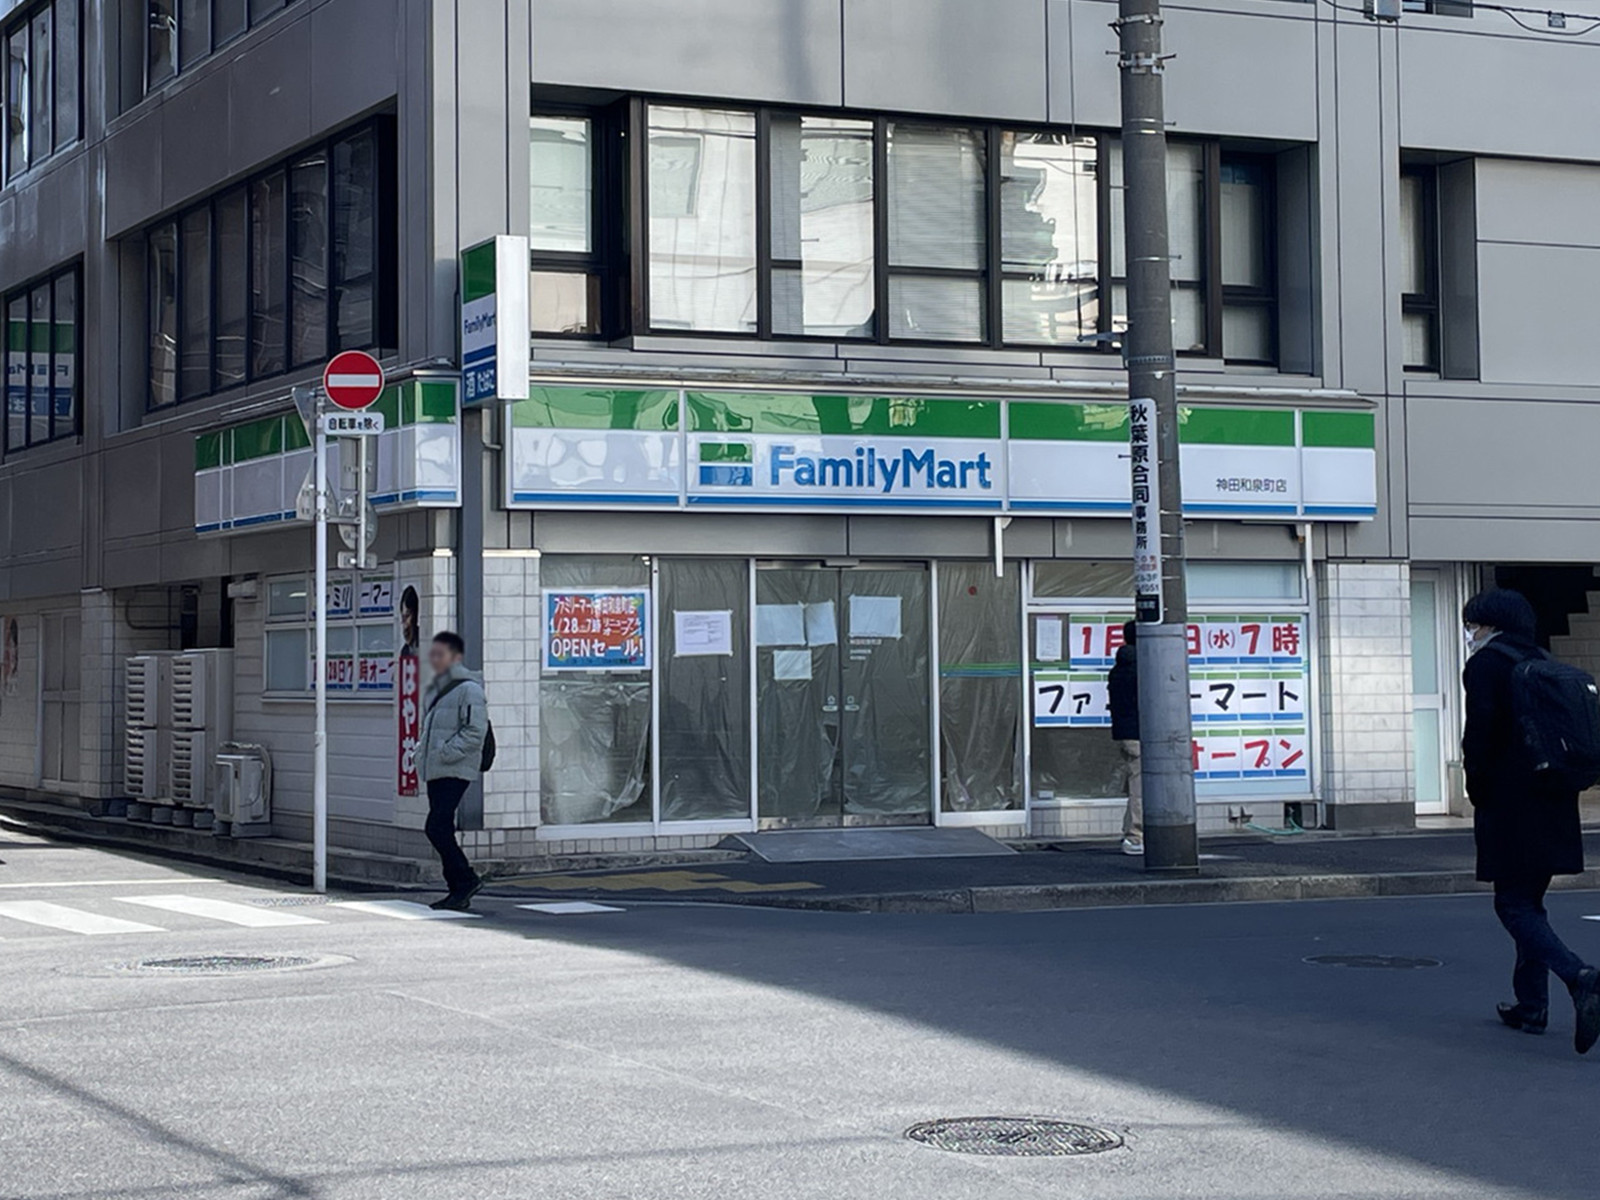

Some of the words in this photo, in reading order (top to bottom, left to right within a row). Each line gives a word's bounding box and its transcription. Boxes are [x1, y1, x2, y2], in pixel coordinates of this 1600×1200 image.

[328, 417, 379, 430] 自転車を除く
[770, 445, 992, 493] FamilyMart
[1216, 478, 1287, 492] 神田和泉町店
[551, 638, 643, 657] OPENセール!
